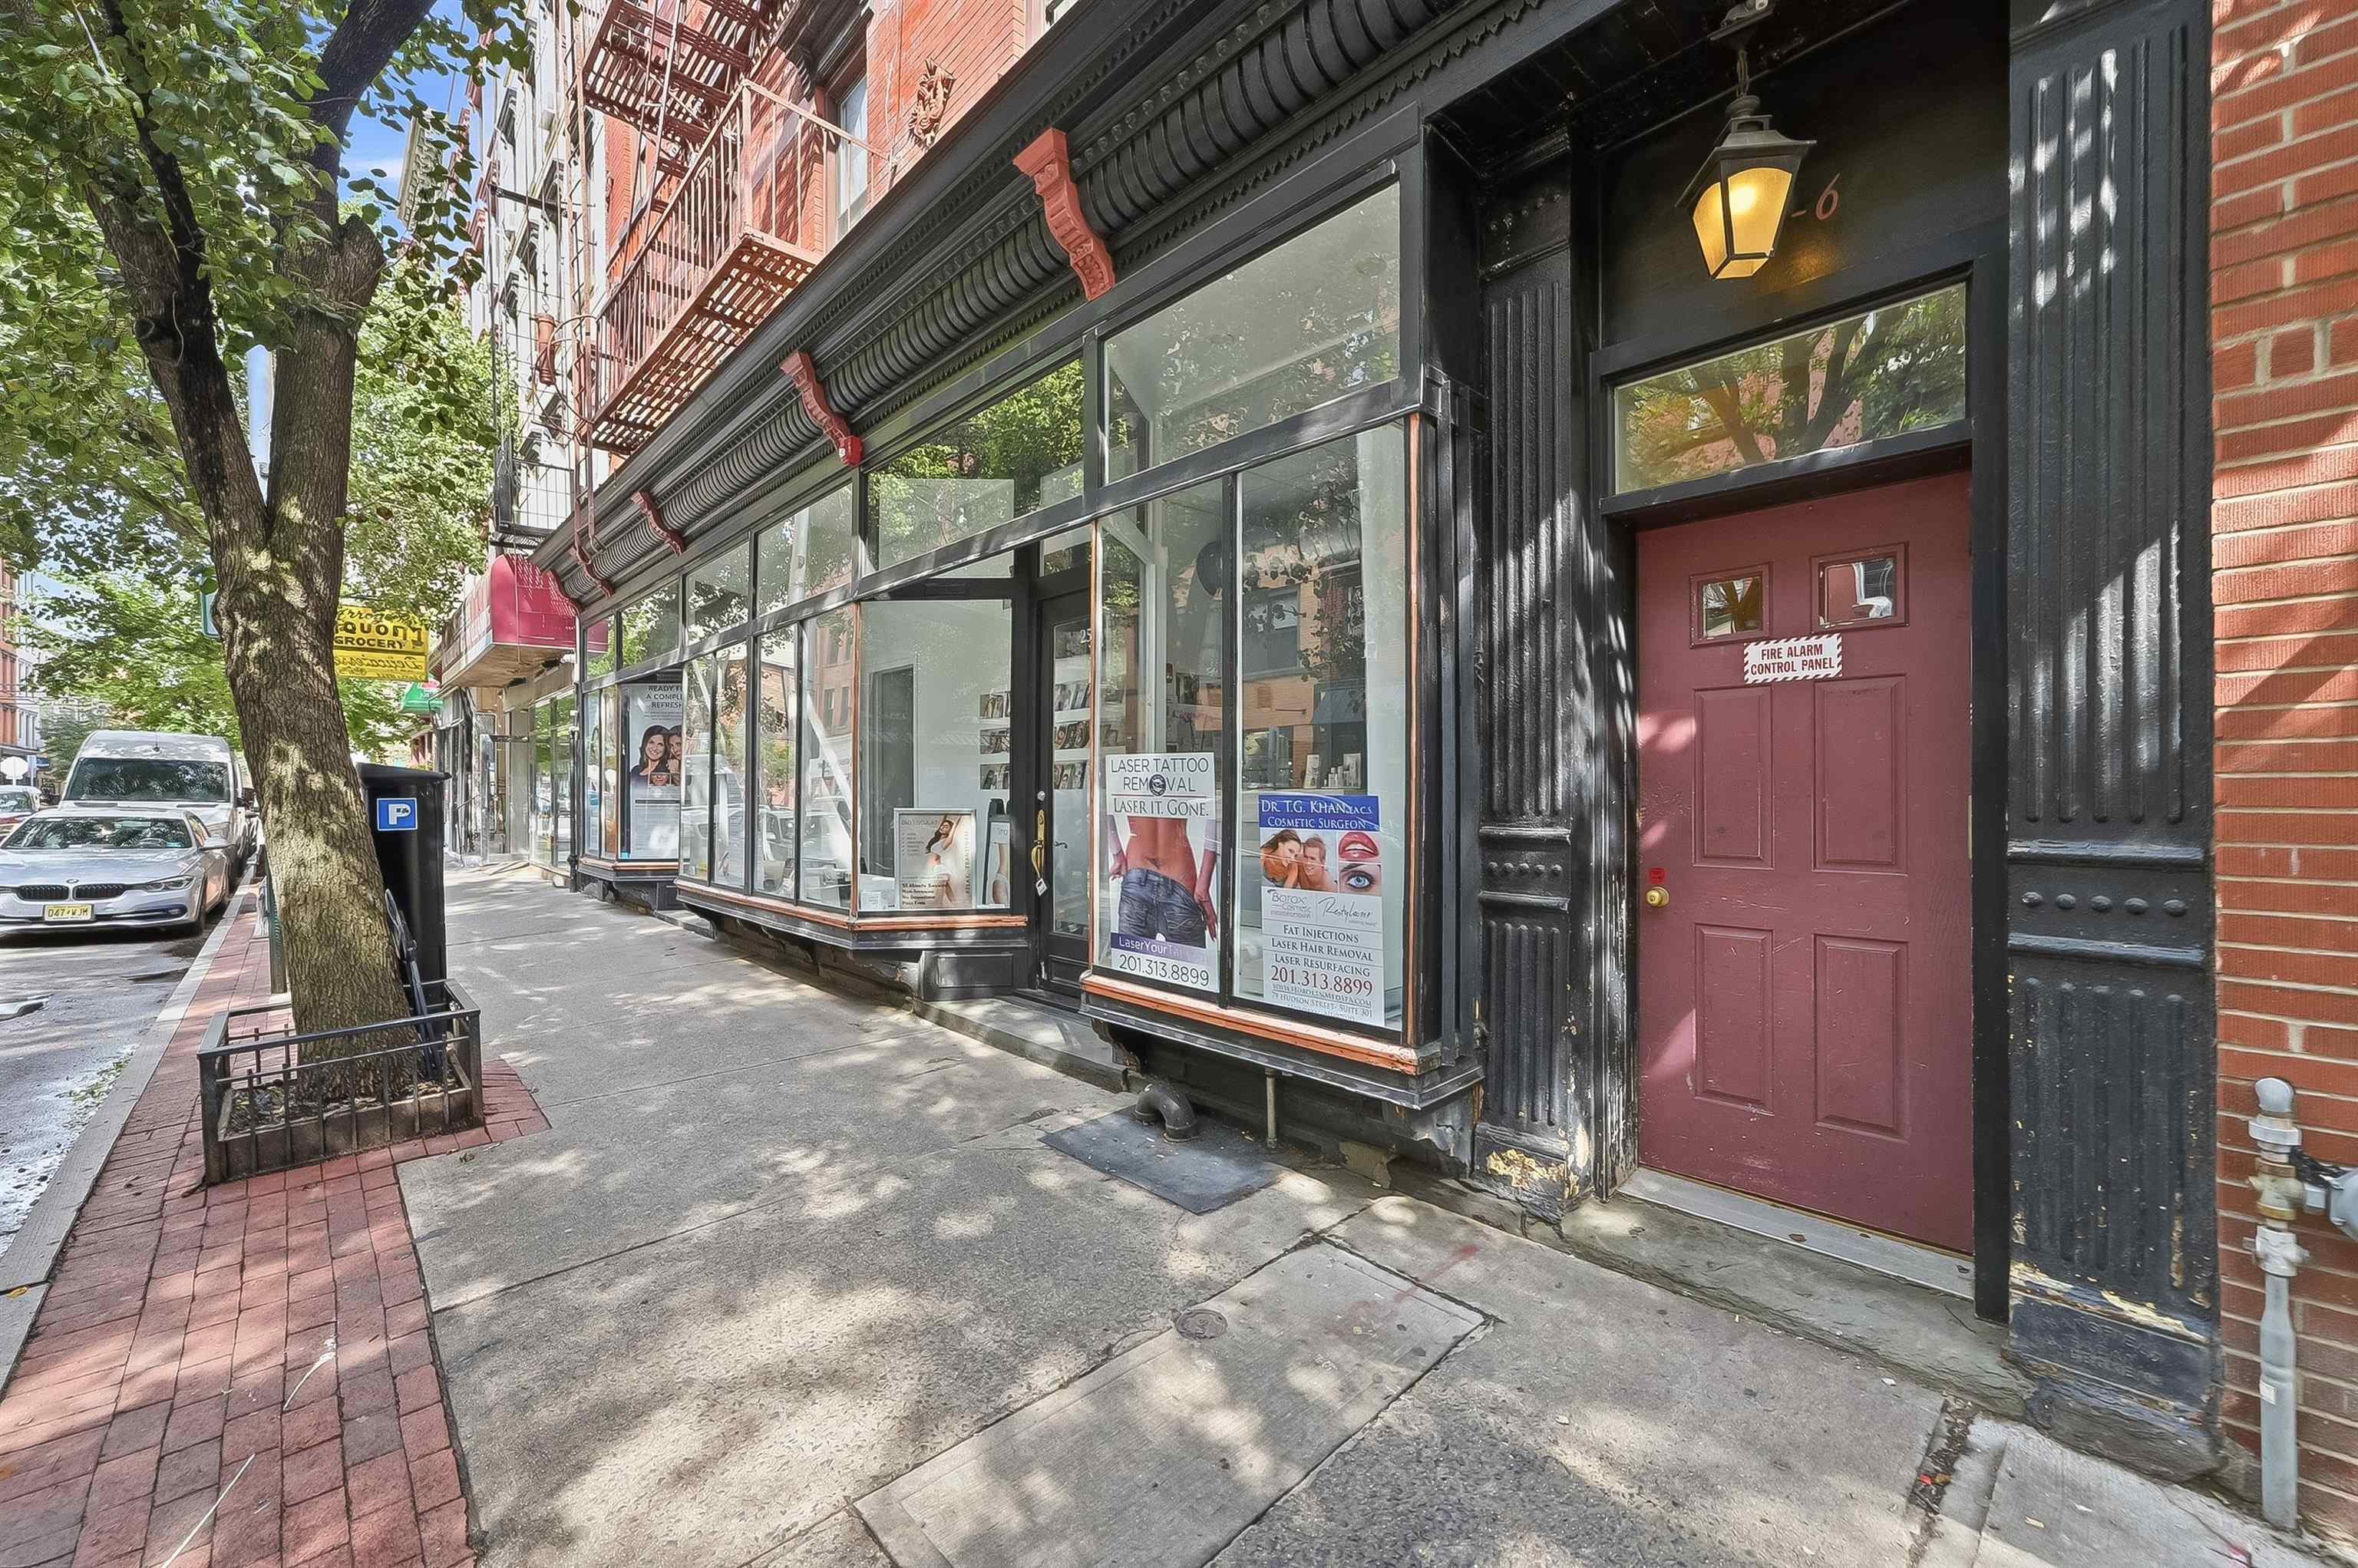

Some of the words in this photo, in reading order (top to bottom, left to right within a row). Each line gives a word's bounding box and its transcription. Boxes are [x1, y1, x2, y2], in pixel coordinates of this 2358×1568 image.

[1761, 647, 1783, 661] FIRE
[1786, 643, 1823, 659] ALARM
[1750, 661, 1798, 675] CONTROL
[1801, 657, 1835, 672] PANEL
[1111, 758, 1150, 773] LASER
[1153, 758, 1209, 773] TATTOO
[1113, 797, 1148, 814] LASER
[1285, 800, 1306, 814] T.G.
[1267, 817, 1315, 829] COSMETIC
[1318, 817, 1366, 830] SURGEON
[1283, 924, 1299, 935] FAT
[1303, 926, 1359, 943] INJECTIONS
[1271, 938, 1298, 951] LASER
[1300, 941, 1324, 955] HAIR
[1327, 945, 1373, 962] REMOVAL
[1119, 953, 1210, 987] 201.313.8899
[1274, 953, 1301, 967] LASER
[1303, 957, 1371, 978] RESURFACING
[1270, 965, 1373, 997] 201.313.8899
[1280, 993, 1309, 1005] HUDSON
[1361, 1008, 1372, 1018] 301
